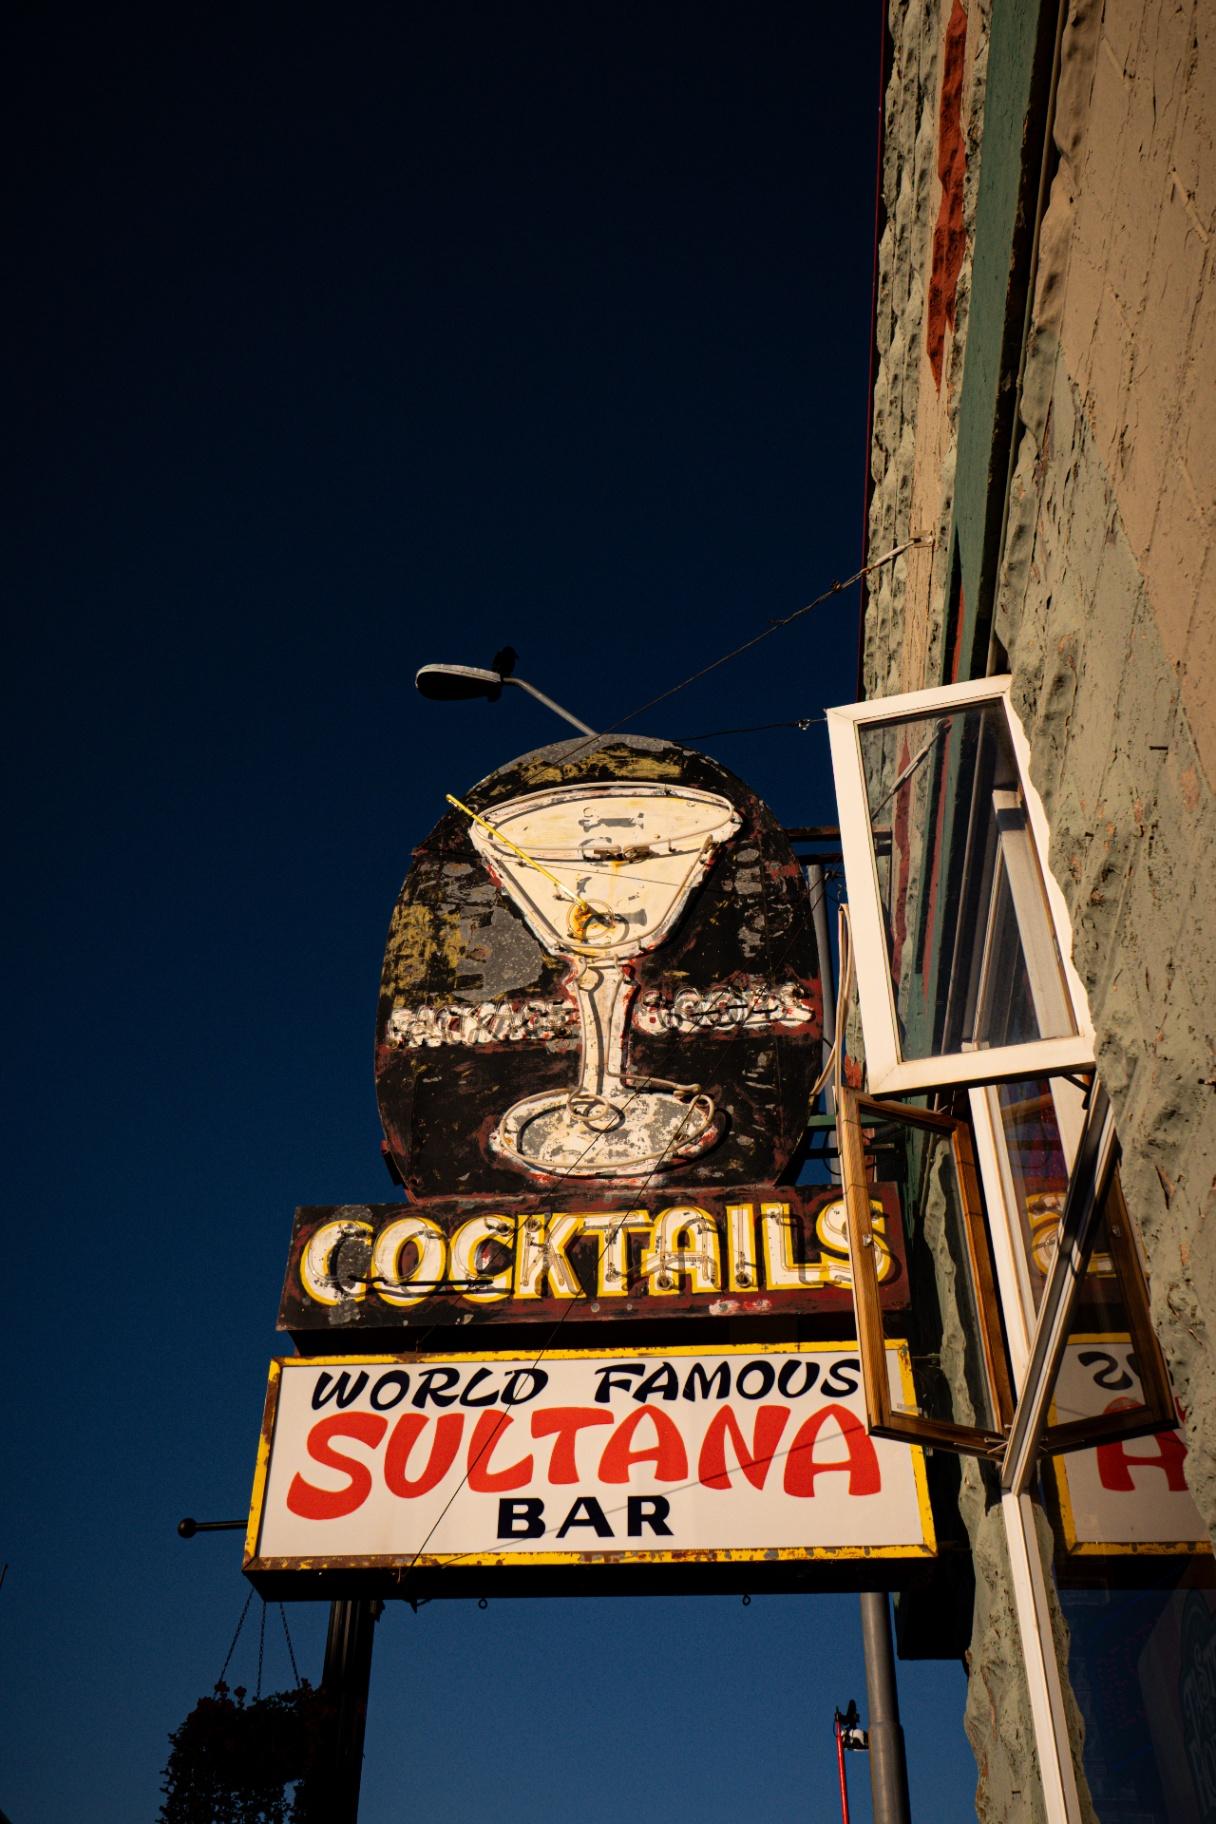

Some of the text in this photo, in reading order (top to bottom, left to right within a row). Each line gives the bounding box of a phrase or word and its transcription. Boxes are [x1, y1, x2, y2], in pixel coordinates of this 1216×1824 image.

[299, 1199, 892, 1307] COCKTAILS
[311, 1358, 861, 1411] WORLD FAMOUS
[286, 1403, 882, 1521] SULTANA
[497, 1494, 675, 1540] BAR
